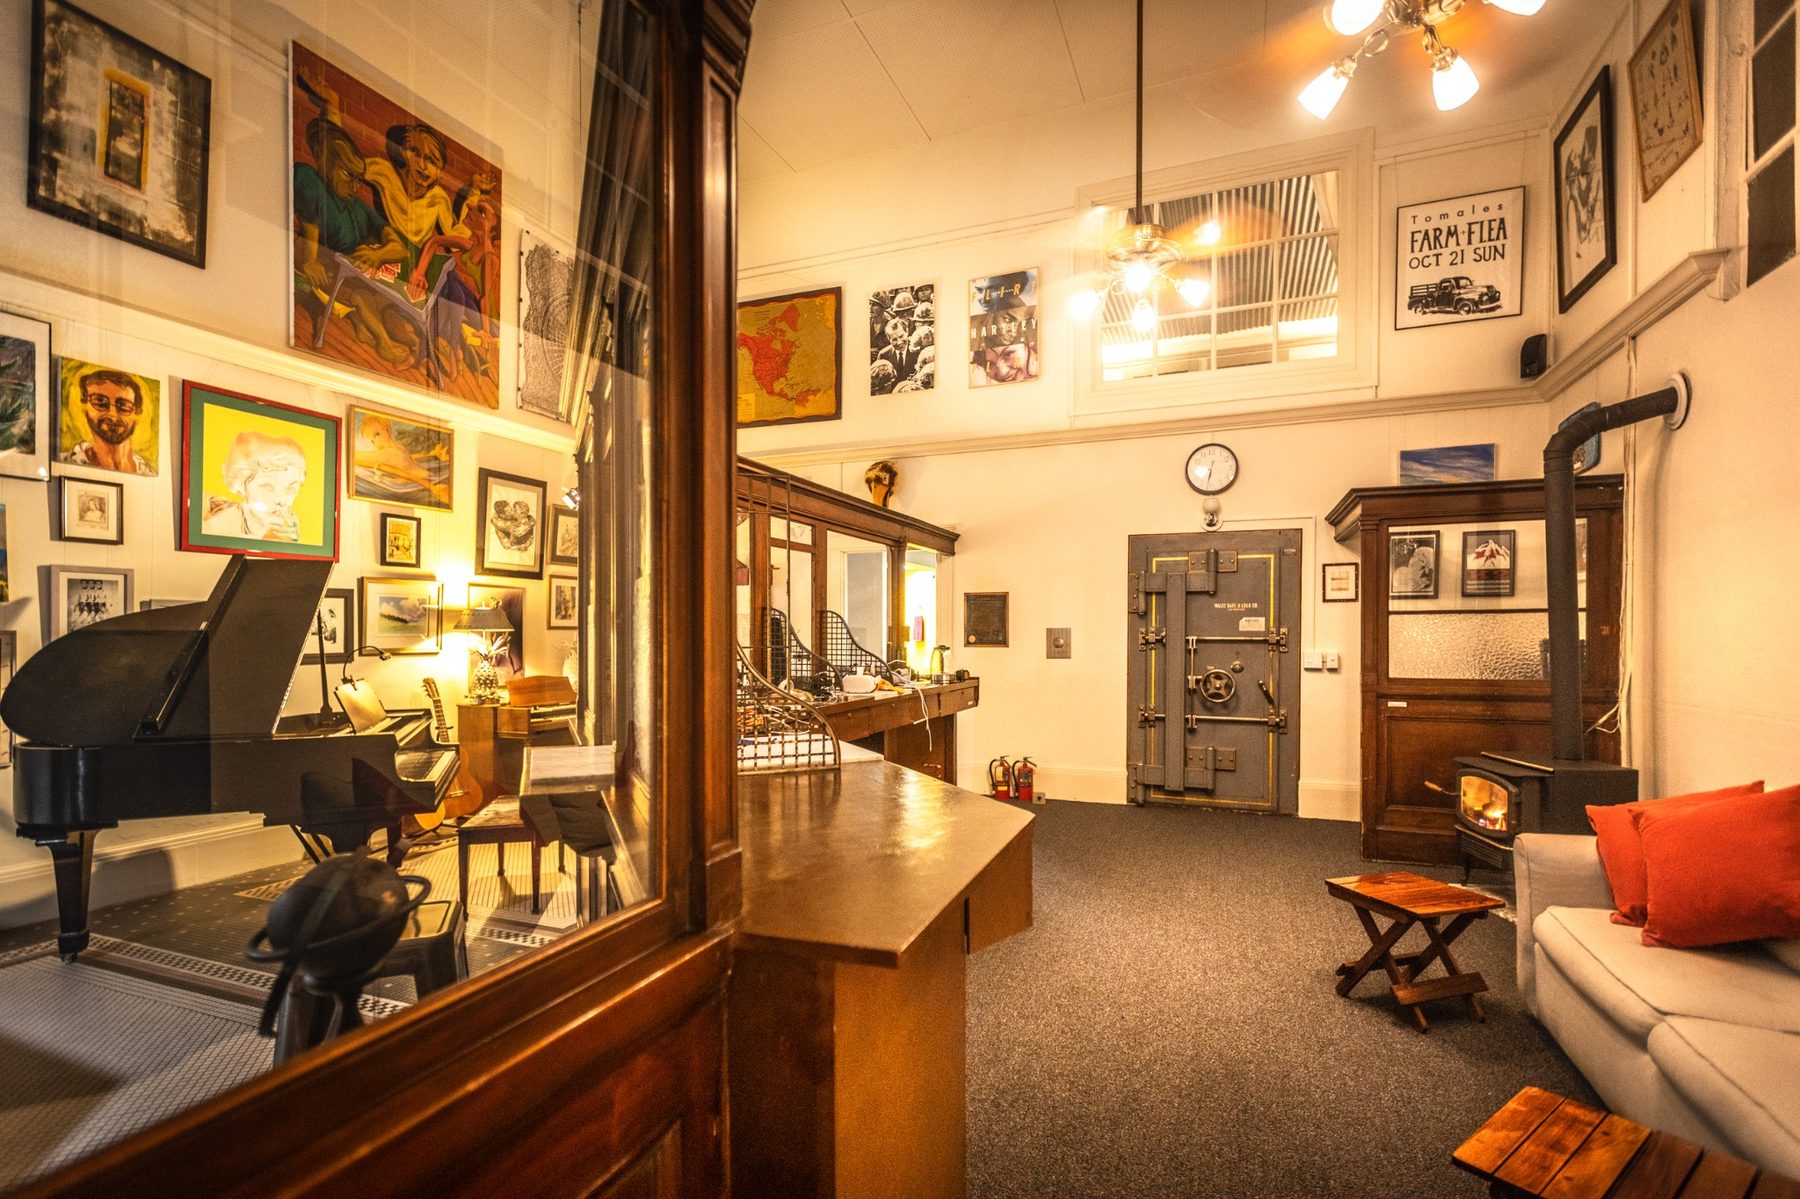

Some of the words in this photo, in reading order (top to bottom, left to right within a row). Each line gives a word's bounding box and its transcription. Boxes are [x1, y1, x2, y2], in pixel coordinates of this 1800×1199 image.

[1411, 203, 1504, 225] Tomales
[1409, 252, 1443, 270] OCT
[1449, 249, 1465, 267] 21
[1473, 243, 1506, 263] SUN
